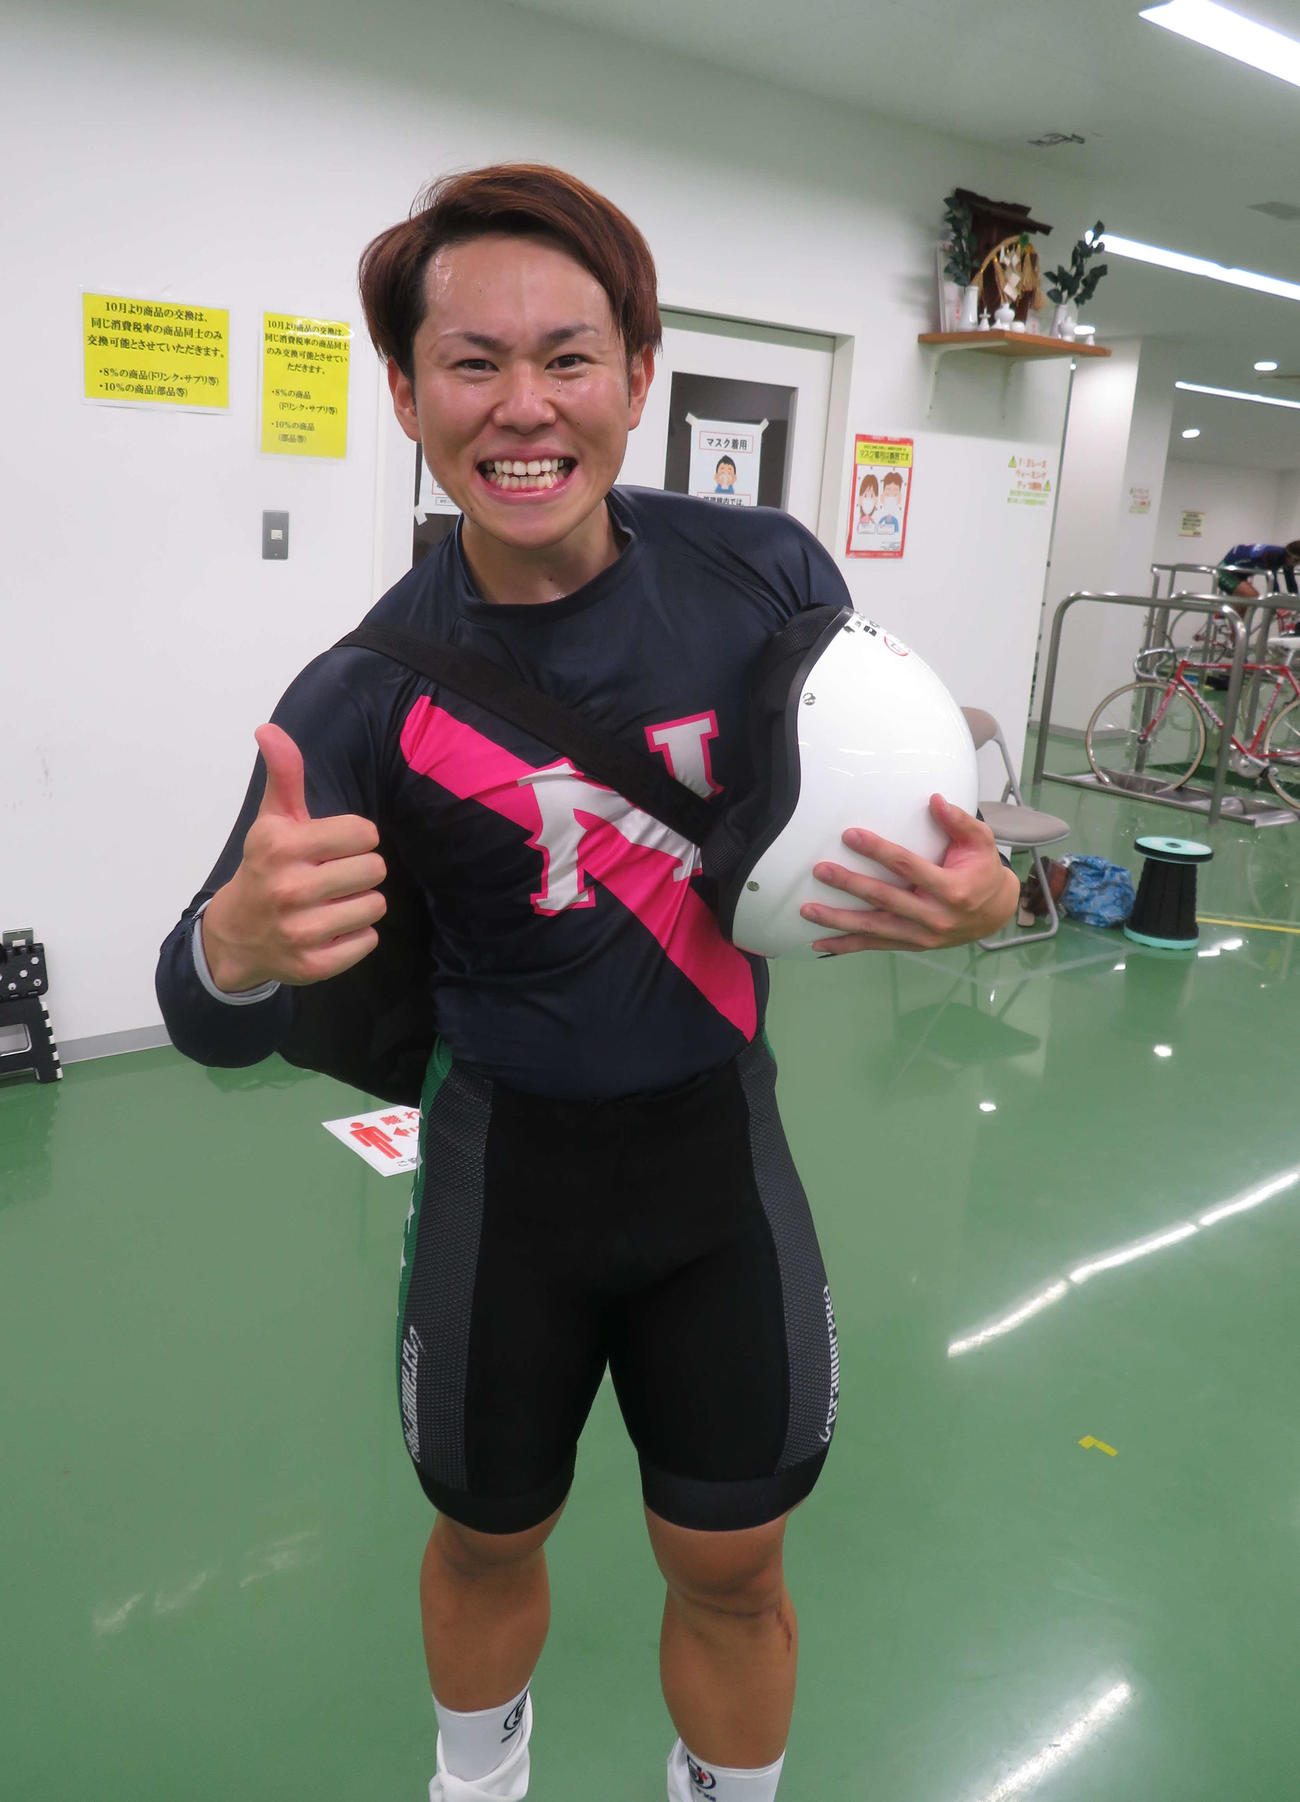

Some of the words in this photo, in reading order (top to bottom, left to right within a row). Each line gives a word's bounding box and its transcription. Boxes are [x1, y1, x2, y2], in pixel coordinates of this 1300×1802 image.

[105, 302, 208, 322] 10月より商品の交換は、
[91, 317, 223, 340] 同じ消費税率の商品同士のみ
[87, 334, 225, 358] 交換可能とさせていただきます。
[706, 438, 748, 450] マスク着用
